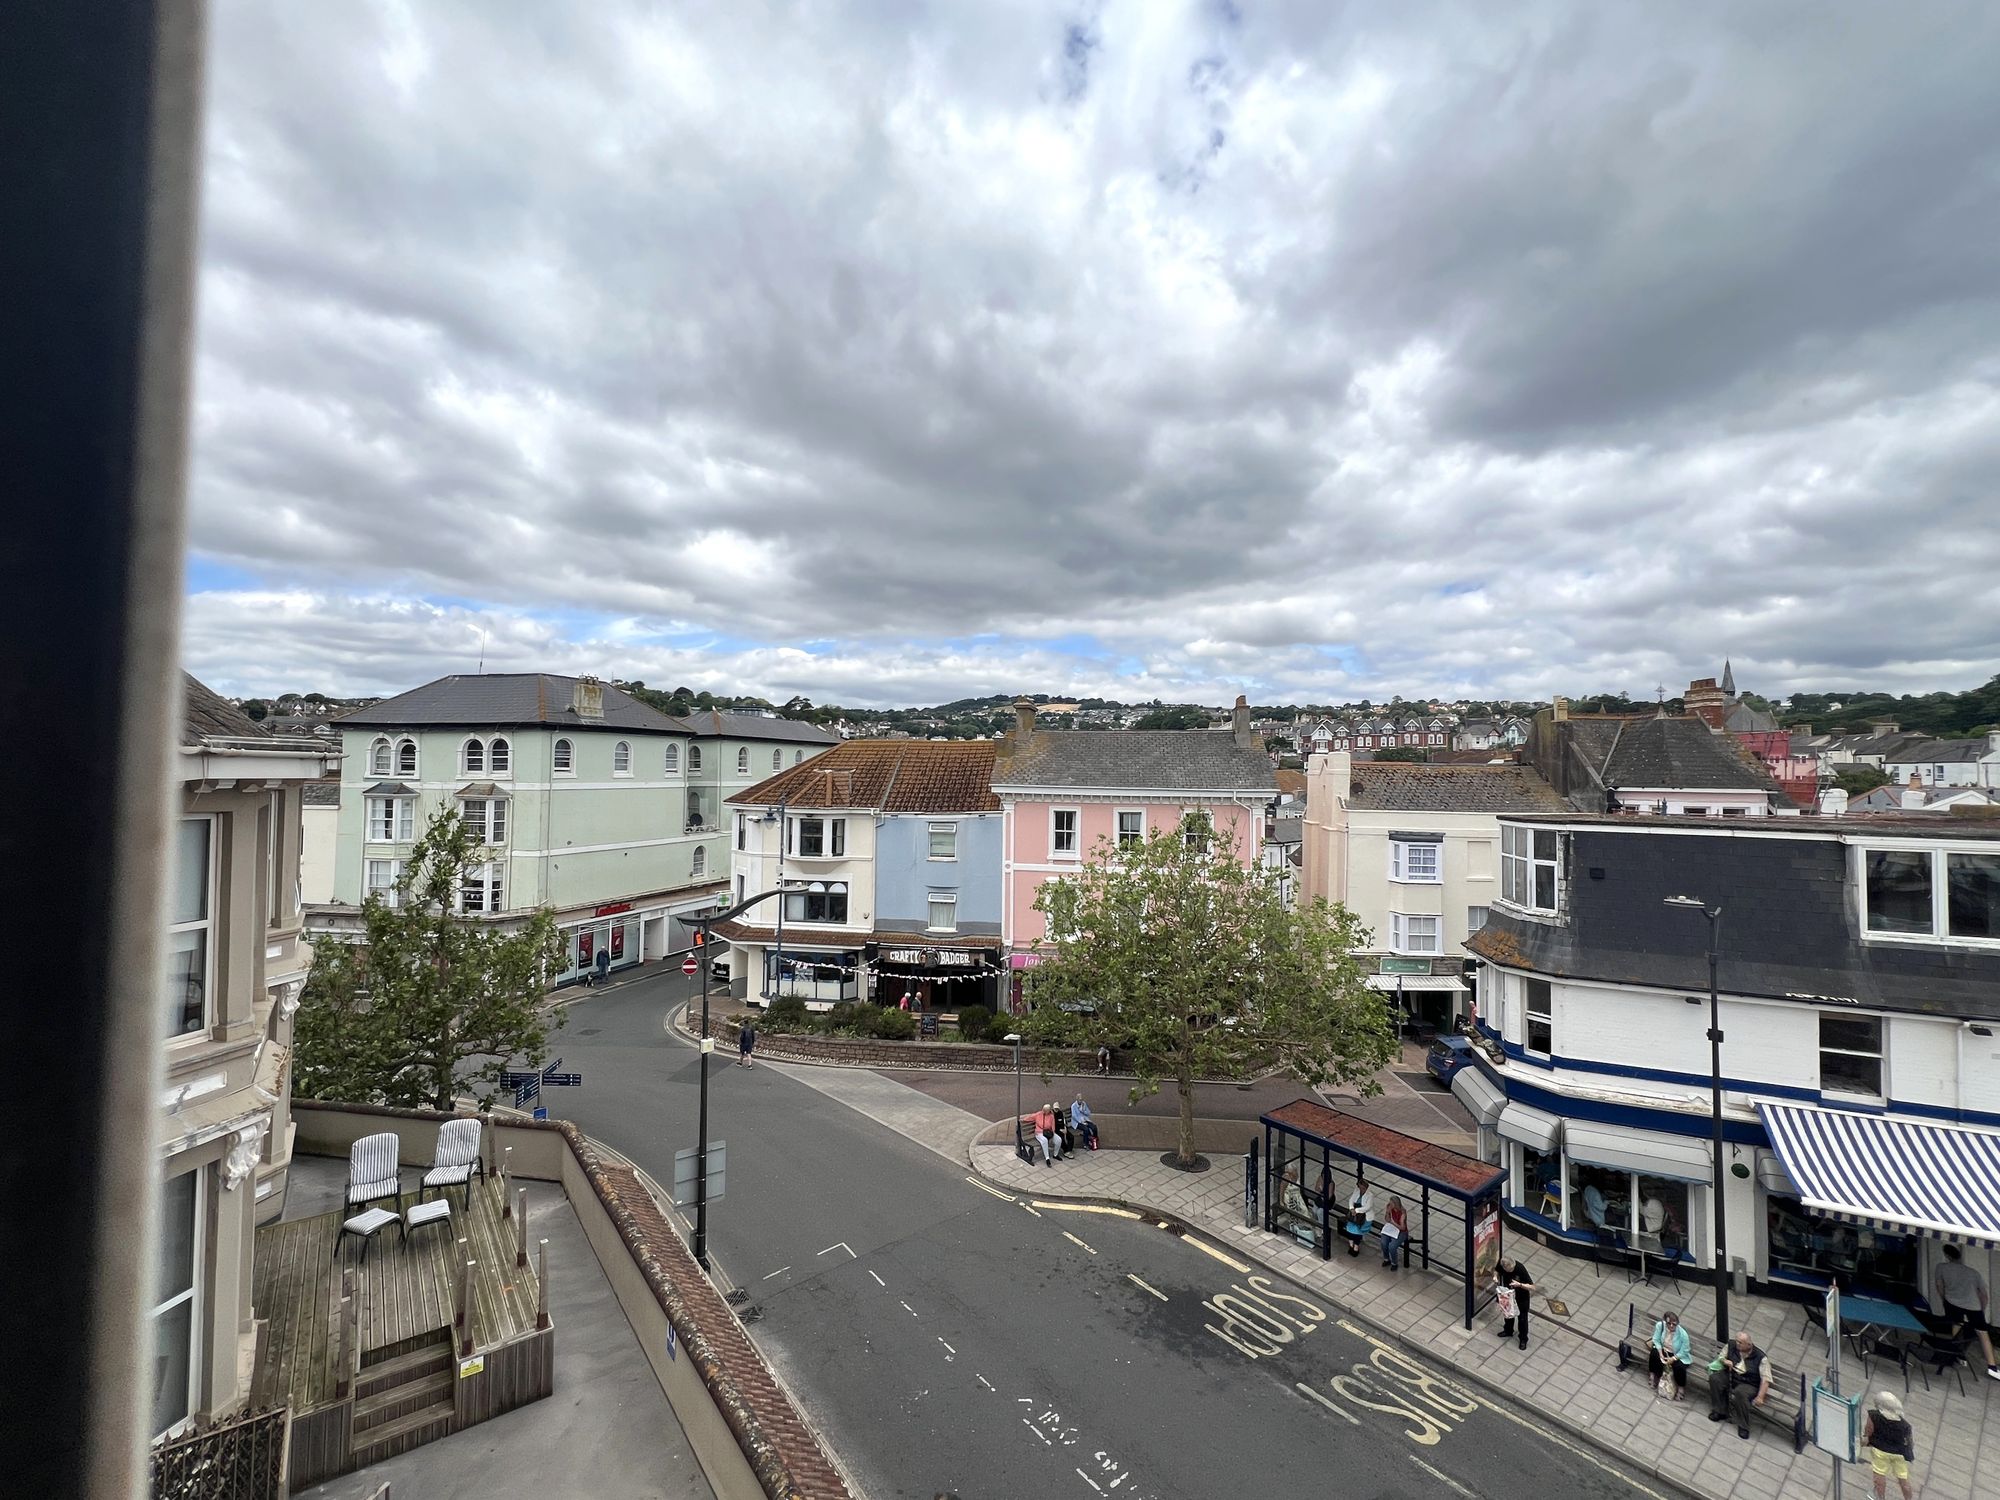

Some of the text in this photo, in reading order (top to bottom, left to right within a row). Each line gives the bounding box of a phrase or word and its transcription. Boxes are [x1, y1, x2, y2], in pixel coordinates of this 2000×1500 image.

[889, 950, 971, 965] CRAFTY BADGER
[1201, 1276, 1327, 1359] STOP
[1330, 1348, 1479, 1446] BUS
